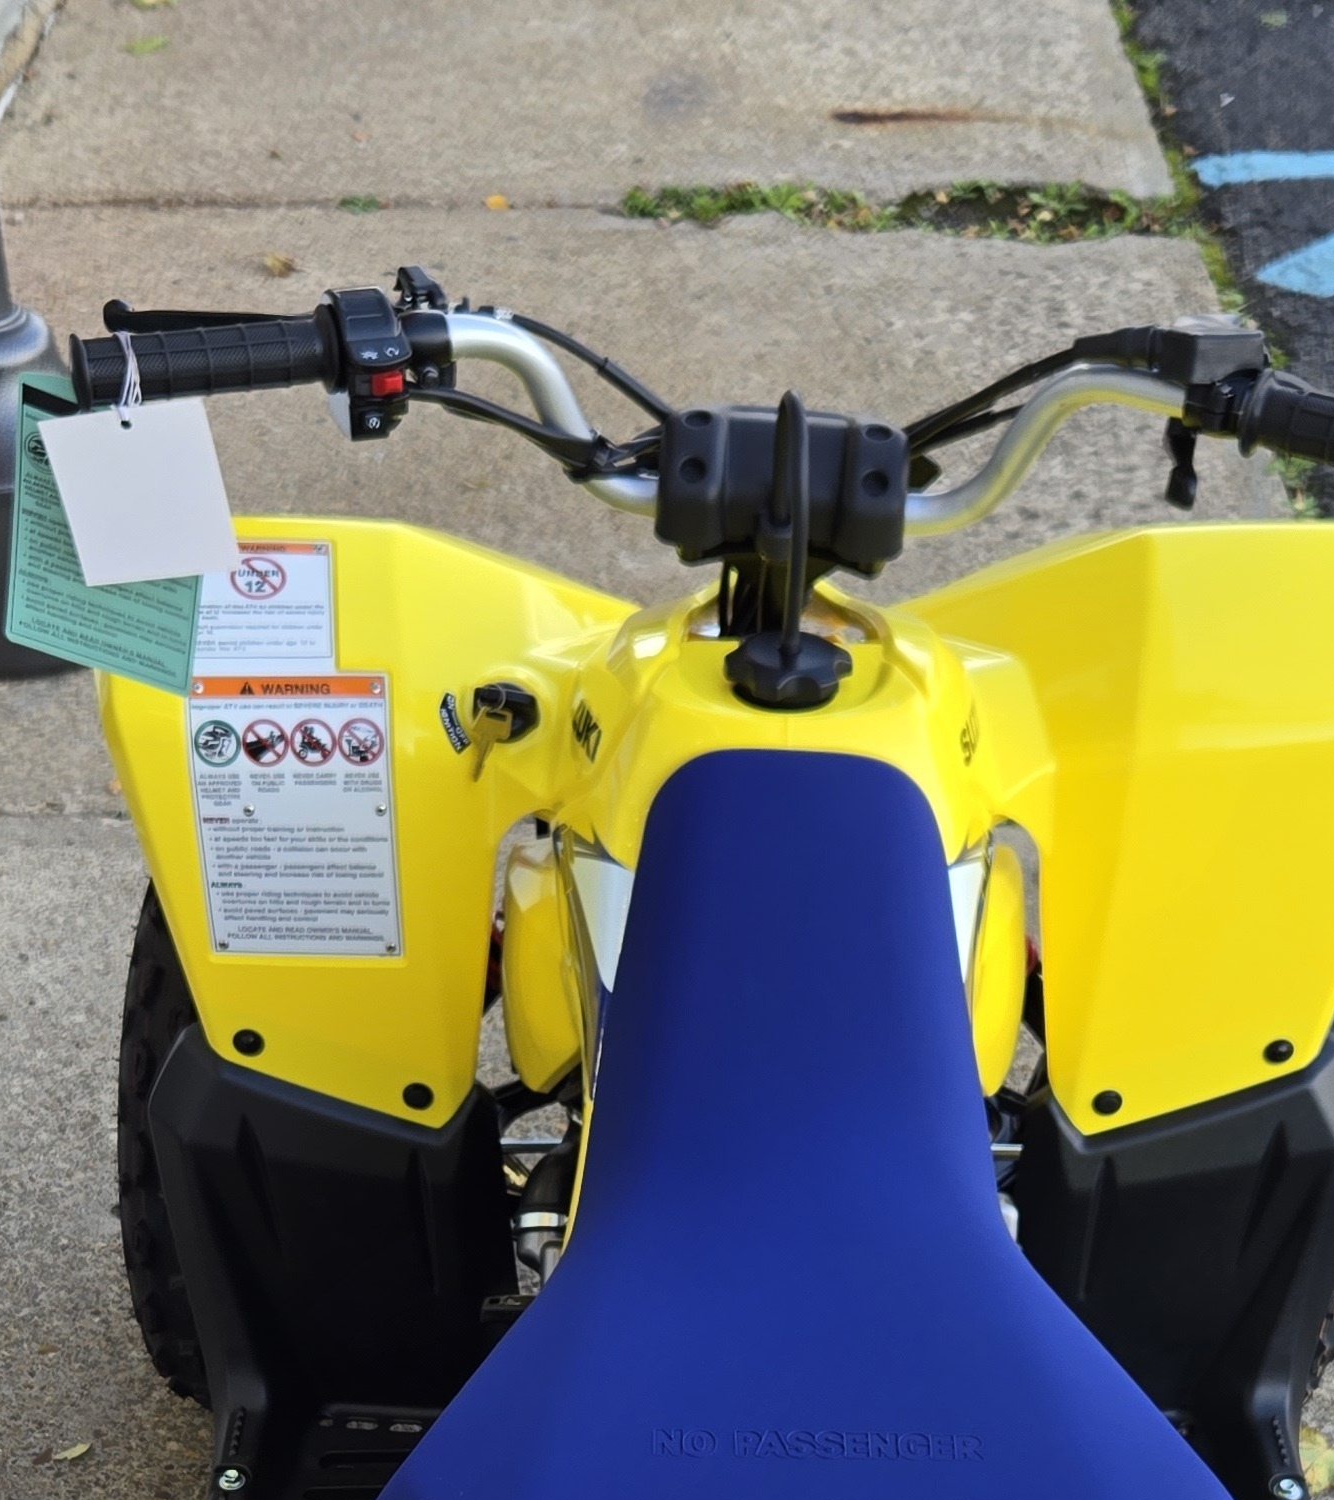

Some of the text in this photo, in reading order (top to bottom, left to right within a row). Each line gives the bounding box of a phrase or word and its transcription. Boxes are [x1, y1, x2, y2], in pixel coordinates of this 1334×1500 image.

[238, 569, 279, 577] UNDER
[245, 581, 266, 592] 12
[261, 684, 330, 694] WARNING
[441, 708, 462, 751] IGNITION
[448, 695, 468, 744] ON OFF
[652, 1428, 986, 1462] NO PASSENGER
